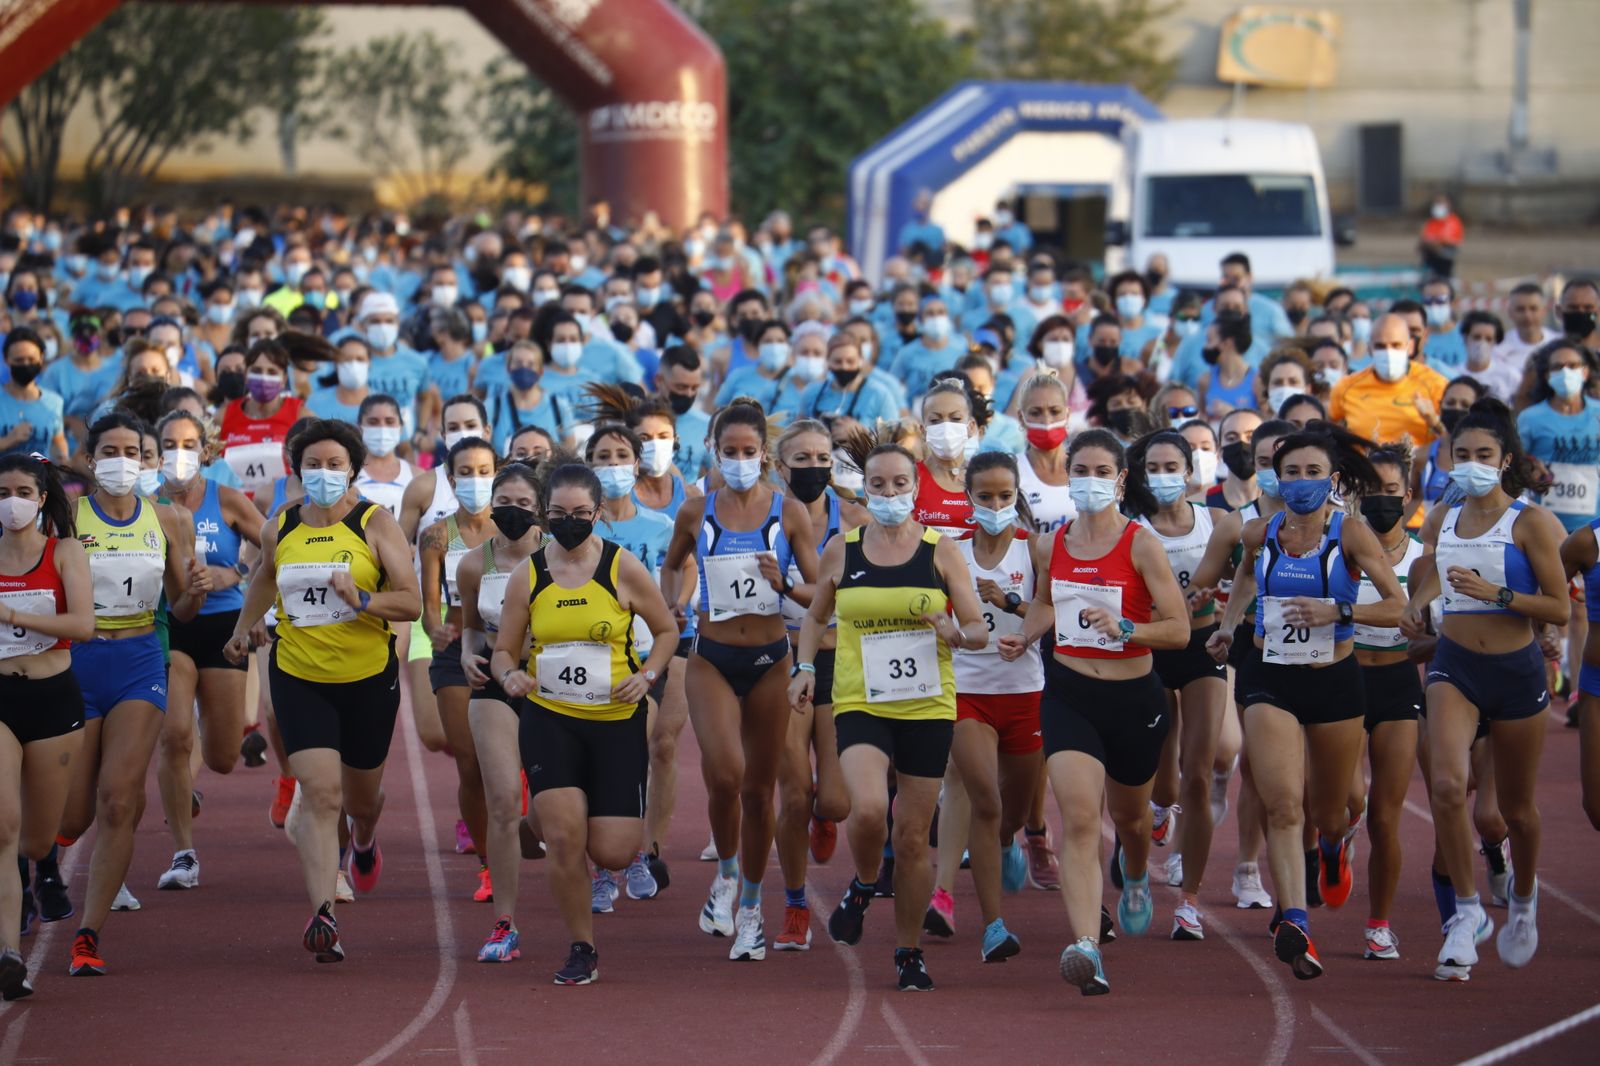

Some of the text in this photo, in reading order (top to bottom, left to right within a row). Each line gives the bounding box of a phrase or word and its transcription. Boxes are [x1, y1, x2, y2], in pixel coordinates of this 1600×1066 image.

[246, 463, 265, 478] 41
[924, 512, 950, 520] califas
[1277, 571, 1315, 580] TROTASIERRA
[122, 577, 133, 596] 1
[303, 587, 328, 605] 47
[729, 578, 757, 599] 12
[854, 617, 927, 629] CLUB ATLETISMO
[983, 612, 995, 632] 3
[1282, 624, 1311, 643] 20
[558, 666, 587, 685] 48
[888, 658, 917, 679] 33
